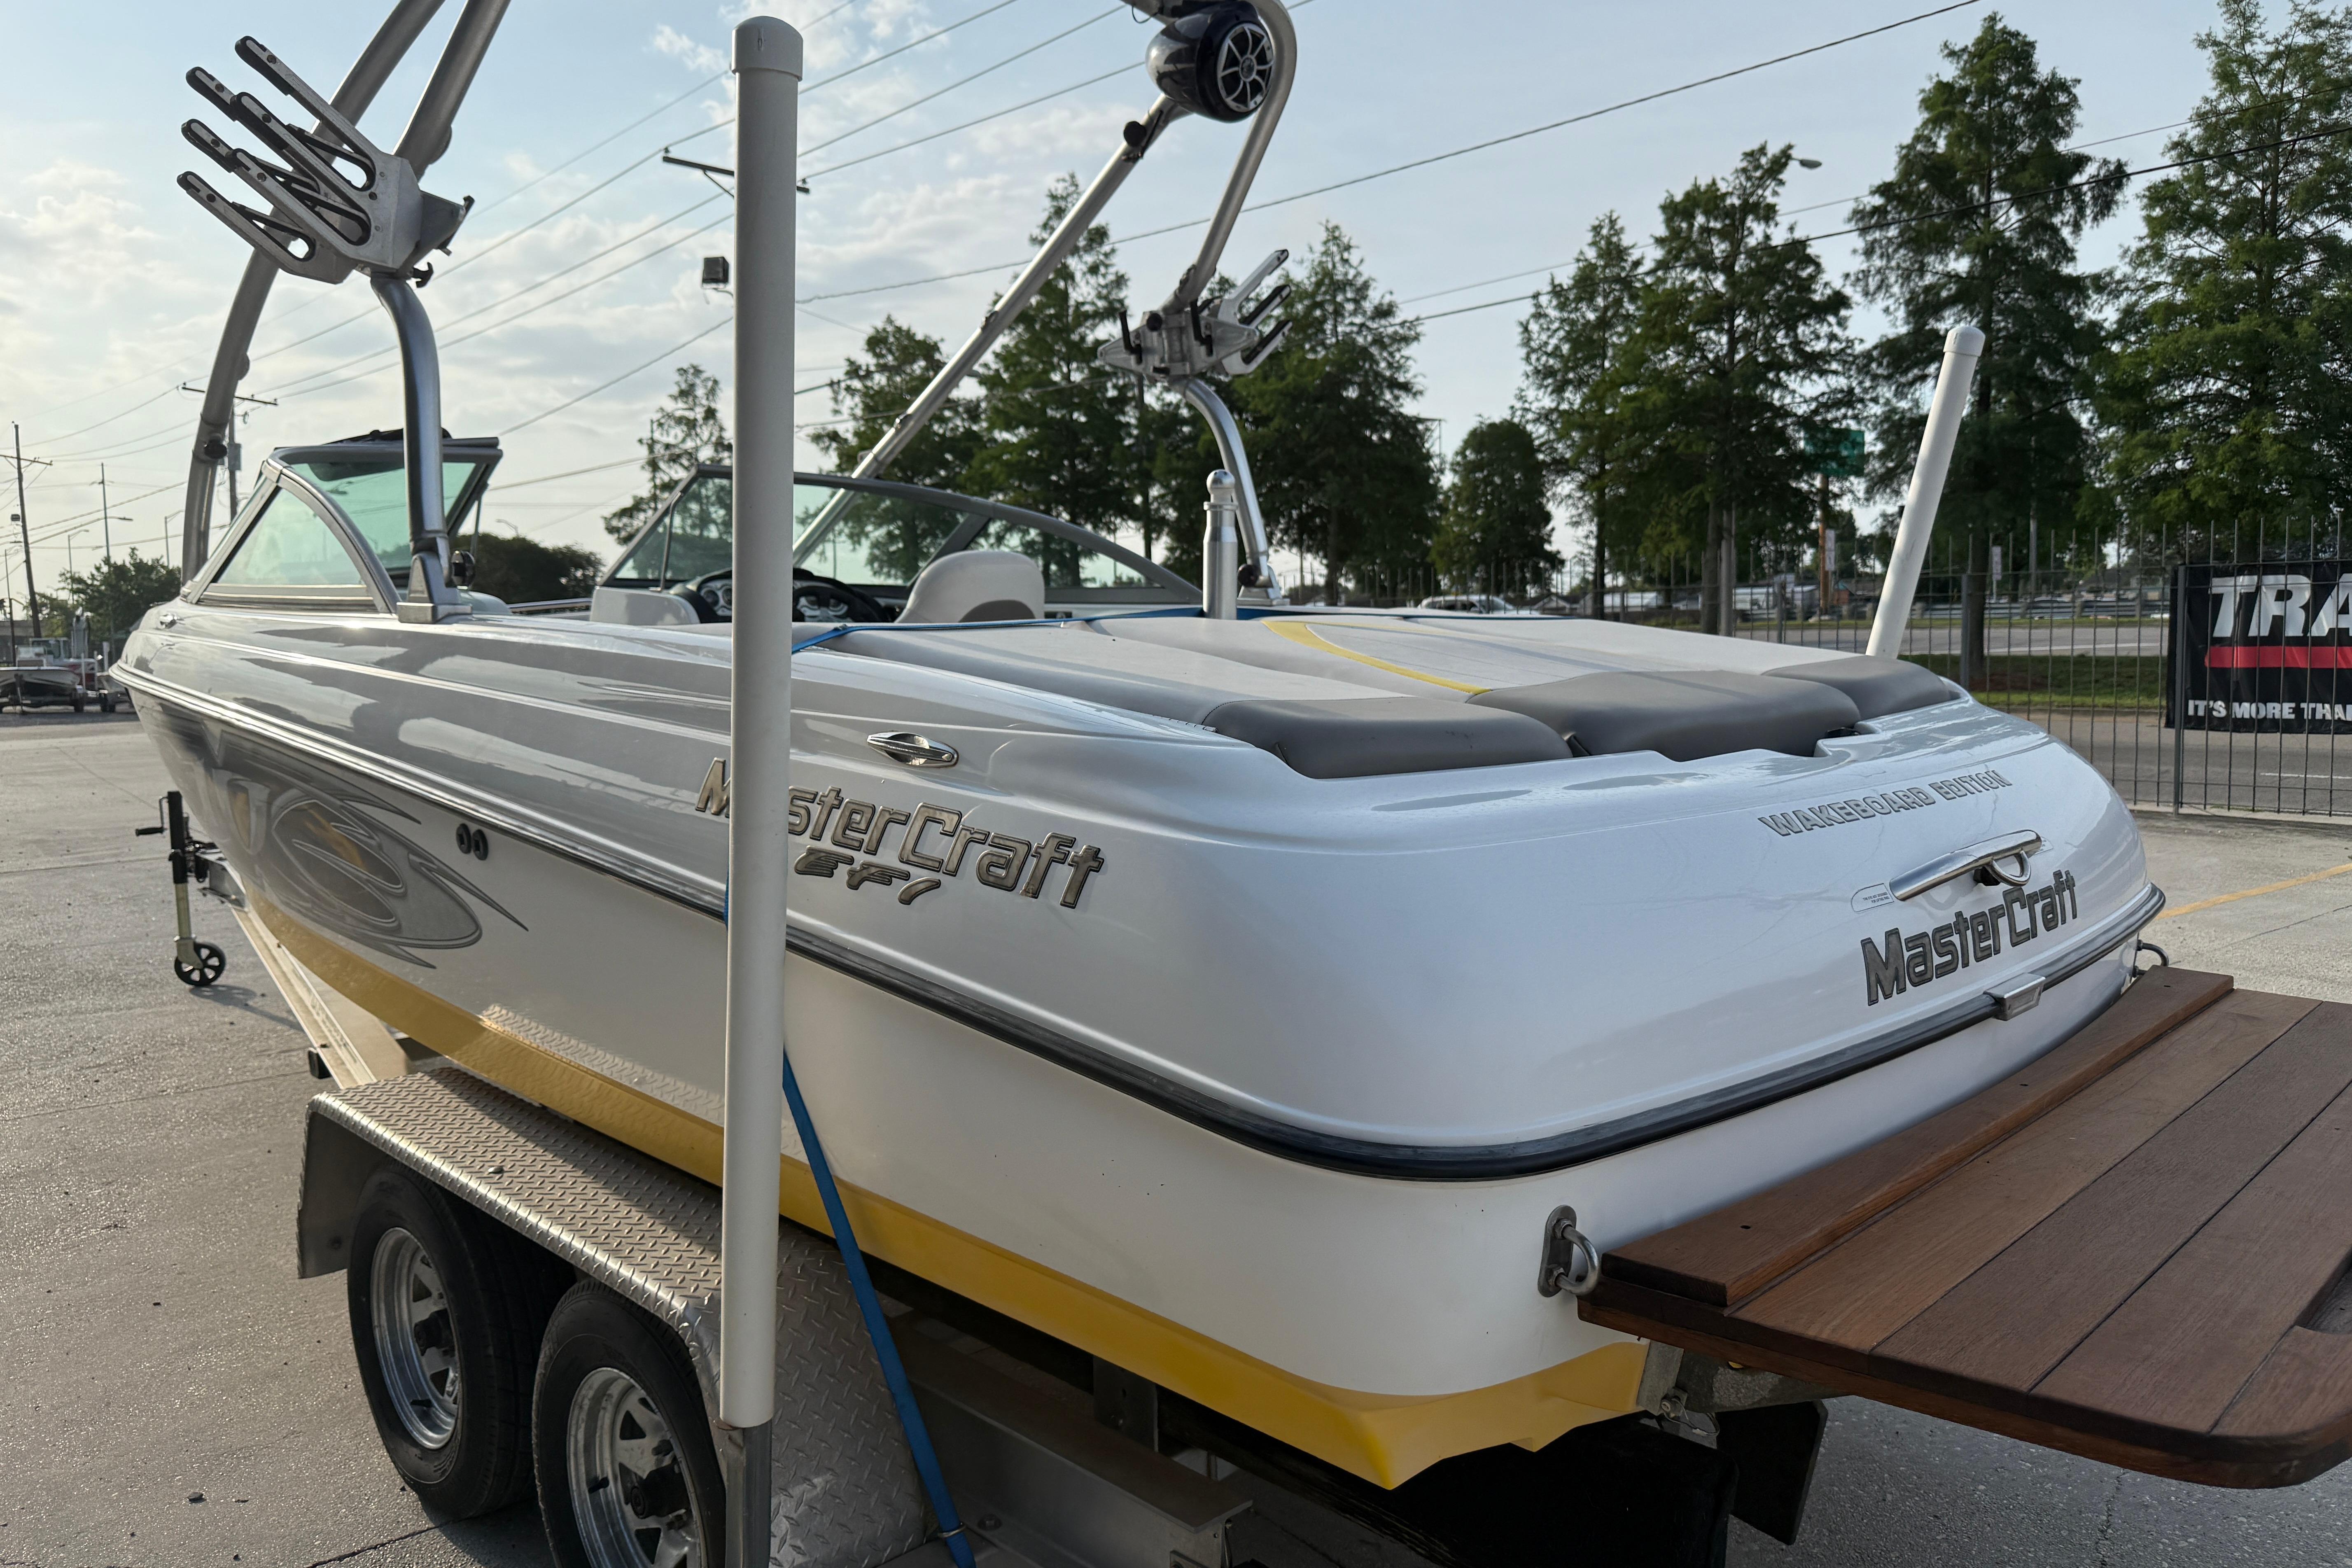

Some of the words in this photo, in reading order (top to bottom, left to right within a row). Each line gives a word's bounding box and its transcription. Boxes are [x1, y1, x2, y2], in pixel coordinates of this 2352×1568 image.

[2209, 573, 2352, 637] TRA
[2232, 702, 2295, 719] MORE
[695, 757, 1105, 909] MsterCraft
[1757, 787, 1936, 837] WAKEBOARD
[1930, 770, 2013, 800] EDITION
[1860, 869, 2078, 1006] MasterCraft
